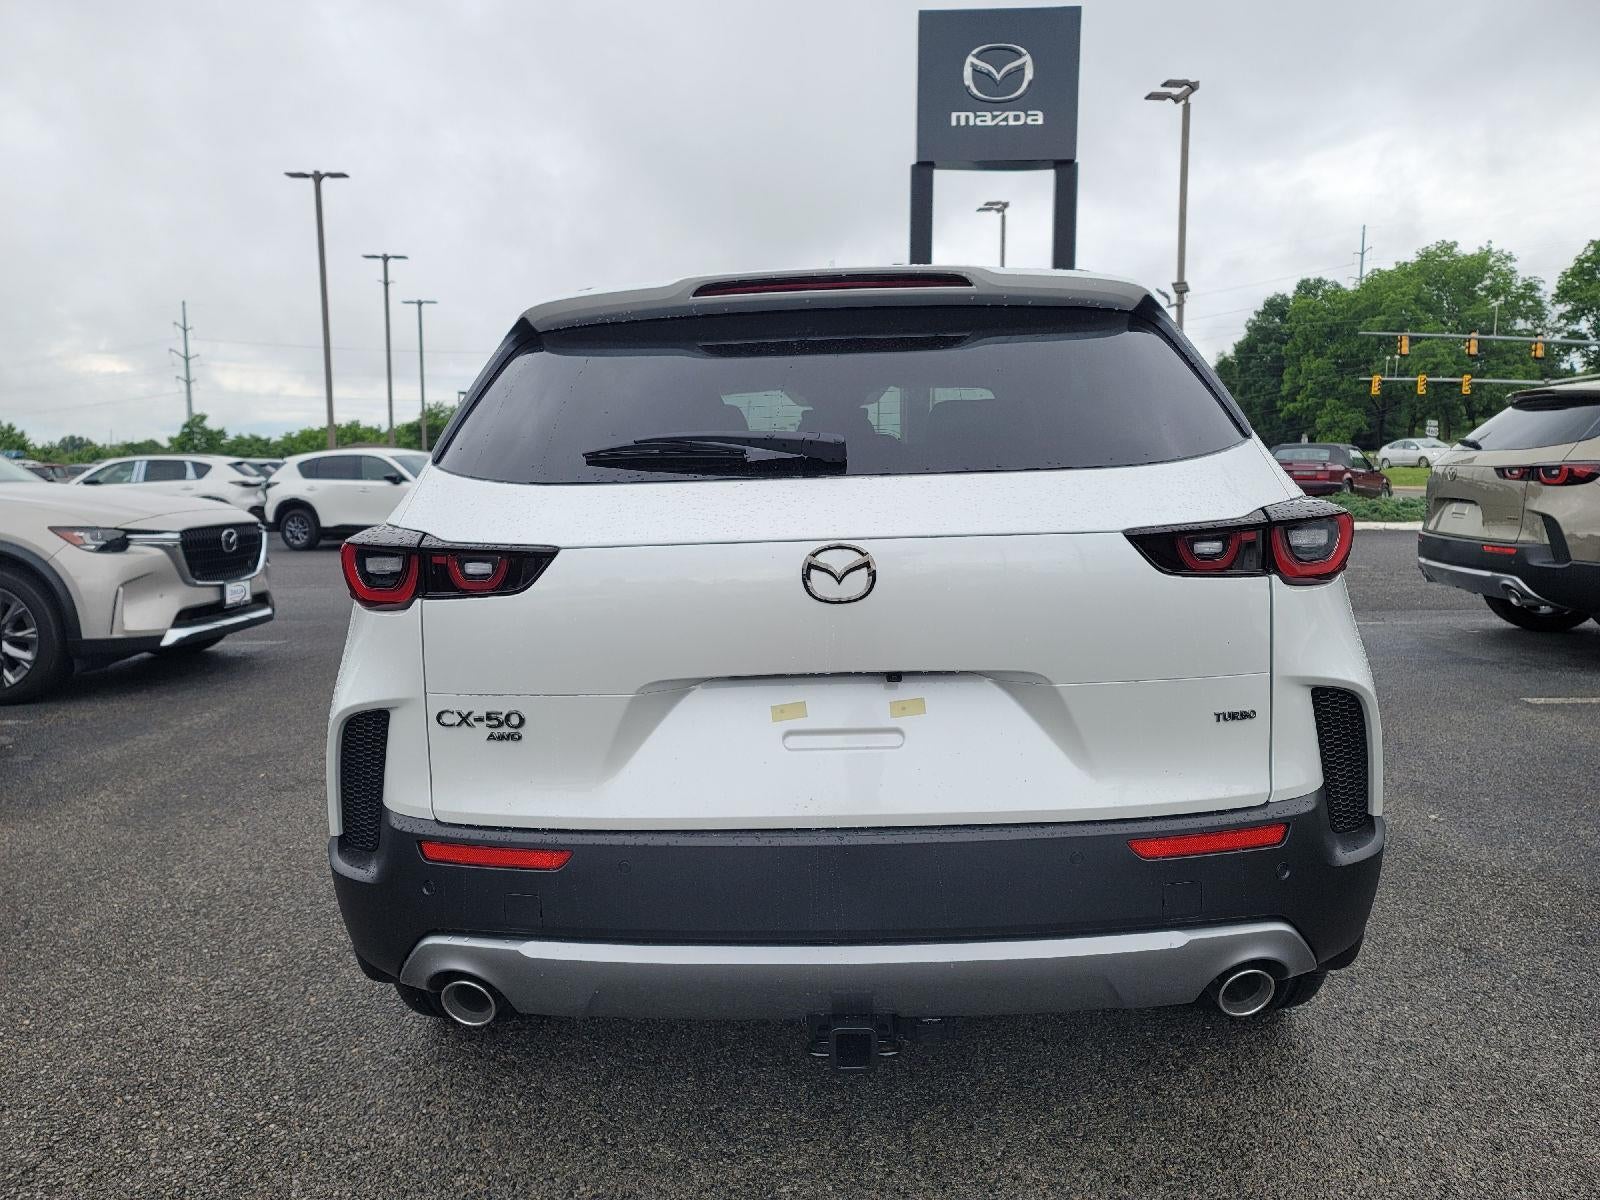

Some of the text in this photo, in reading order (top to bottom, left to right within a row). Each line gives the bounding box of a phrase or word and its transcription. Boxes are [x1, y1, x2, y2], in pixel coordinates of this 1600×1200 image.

[950, 110, 1044, 127] mazda
[436, 709, 525, 729] CX-50
[1213, 709, 1257, 722] TURBO
[486, 731, 522, 741] AWD
